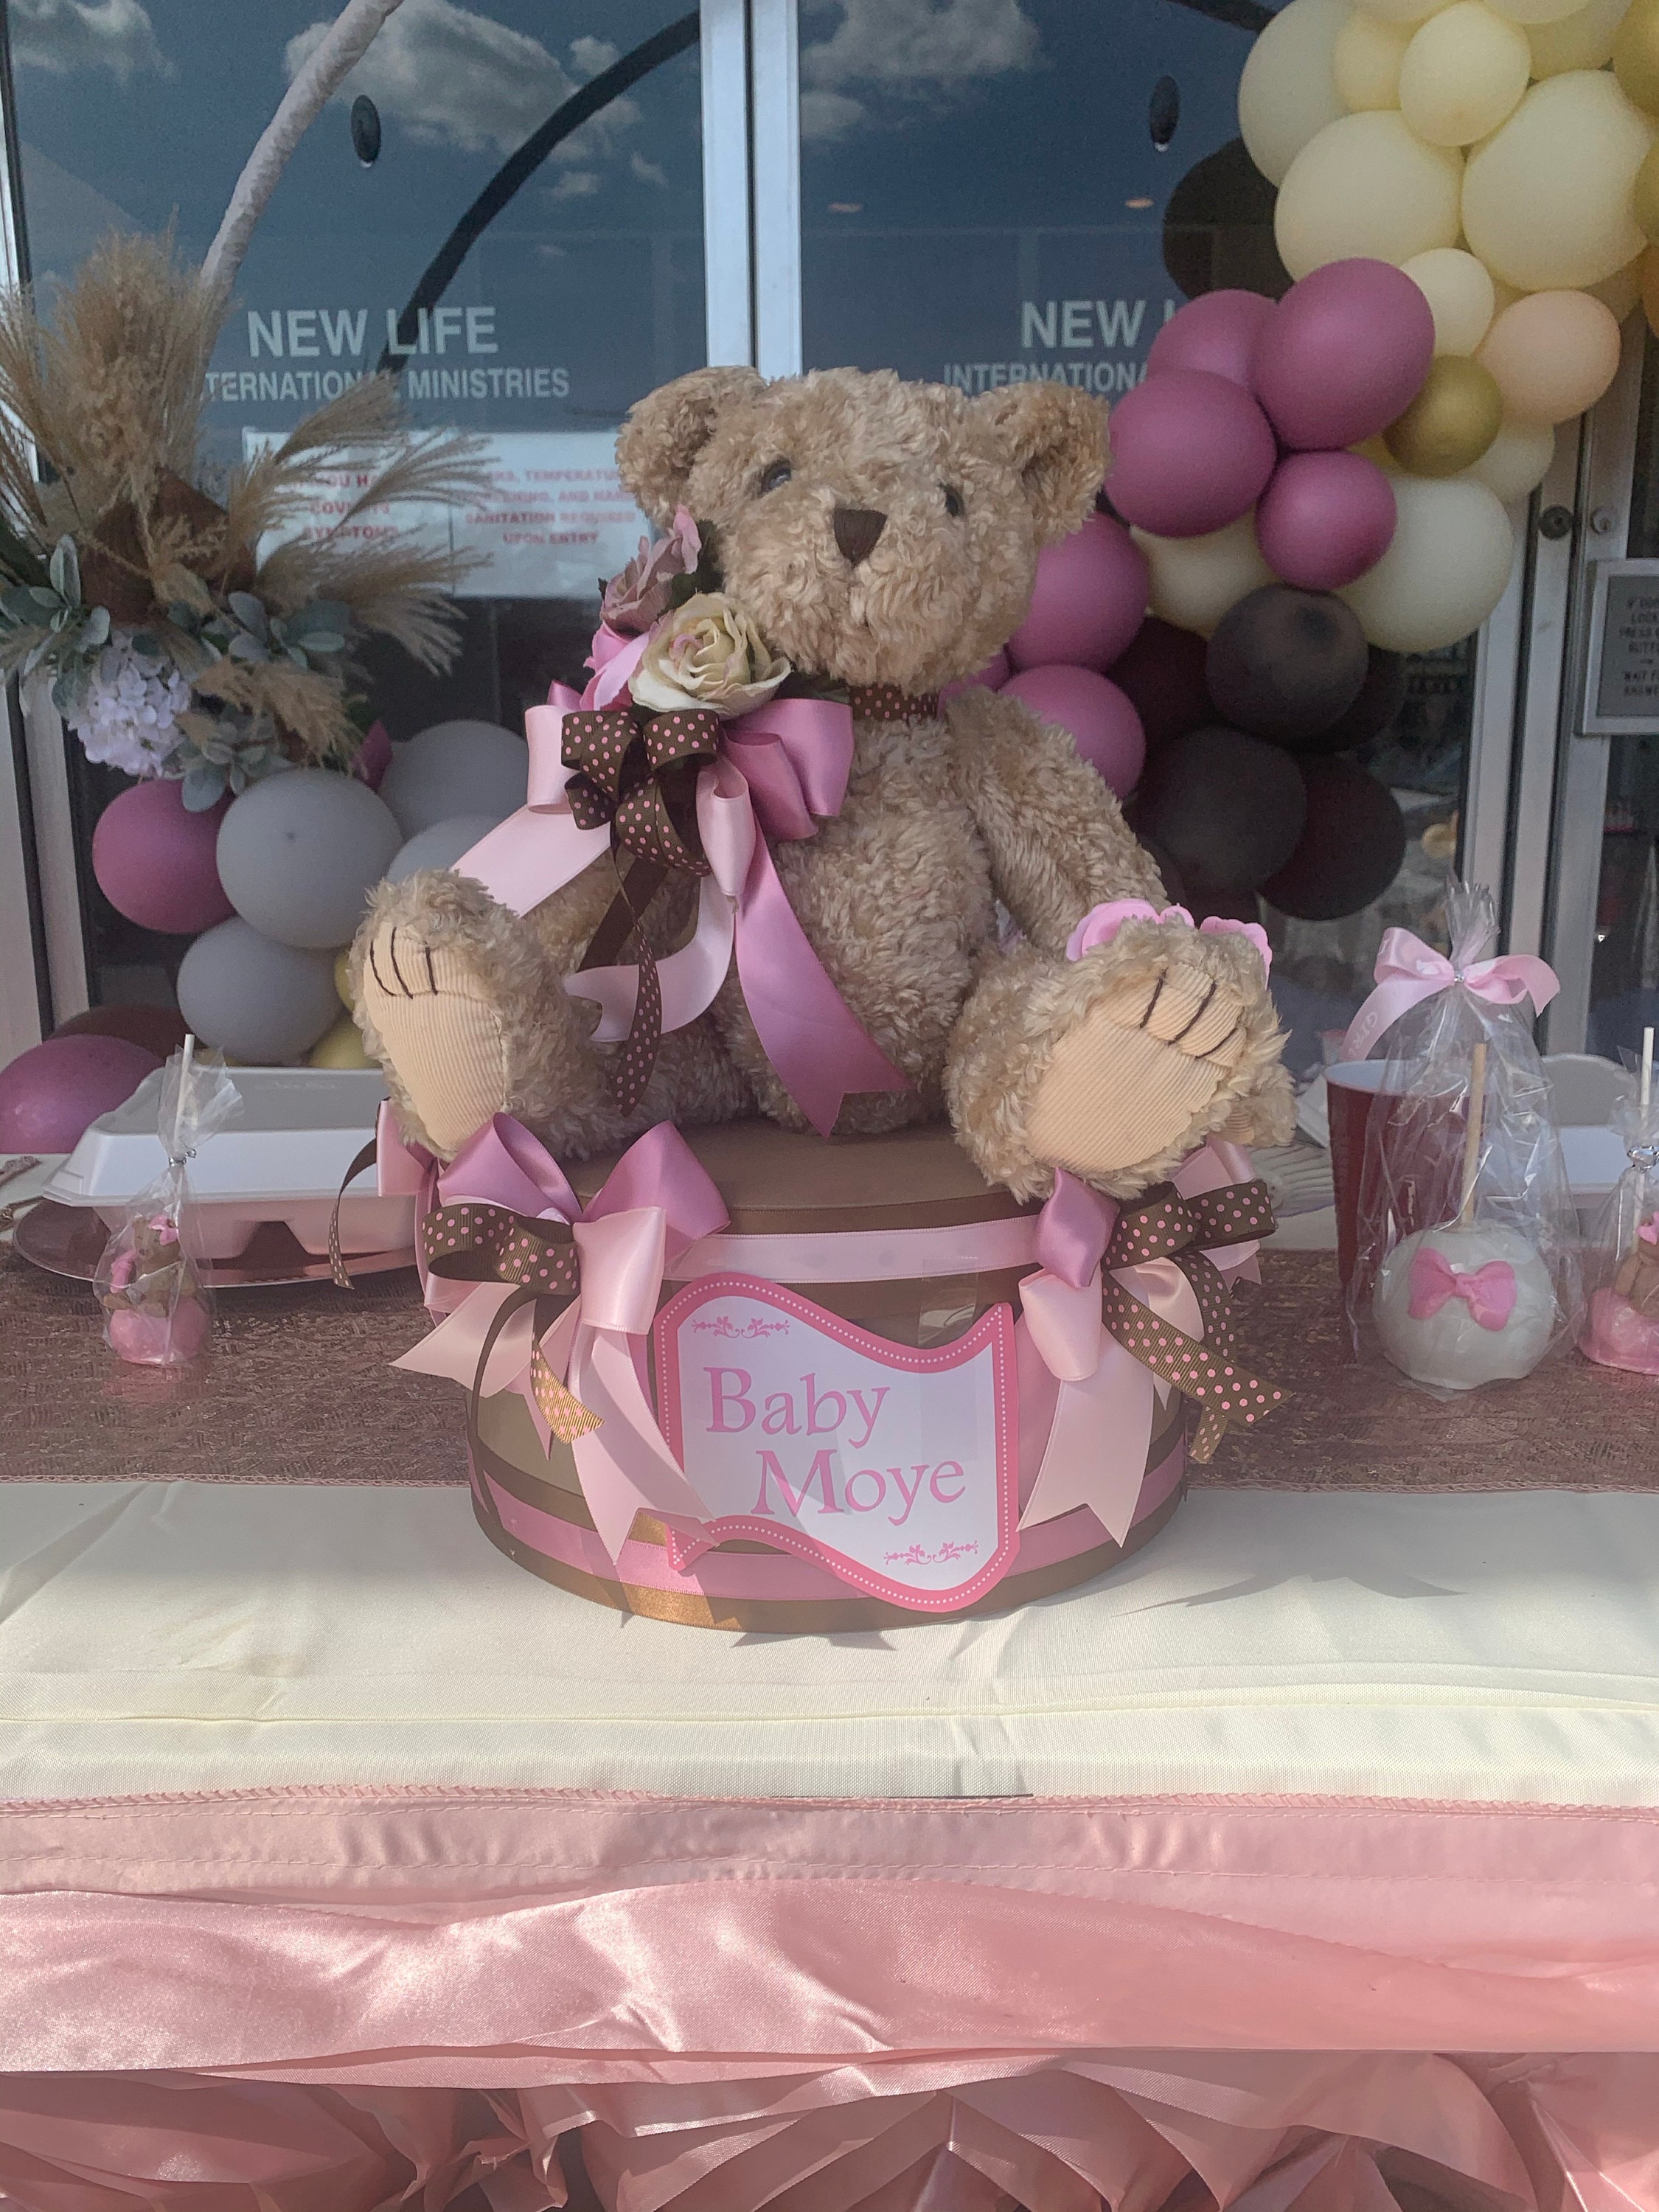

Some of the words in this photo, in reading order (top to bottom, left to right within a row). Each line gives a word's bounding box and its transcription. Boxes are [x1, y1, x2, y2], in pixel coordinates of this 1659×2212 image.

[247, 308, 368, 358] NEW
[386, 305, 499, 355] LIFE
[1021, 299, 1147, 349] NEW
[408, 367, 570, 400] MINISTRIES
[703, 1366, 891, 1449] Baby
[751, 1448, 966, 1526] Moye
